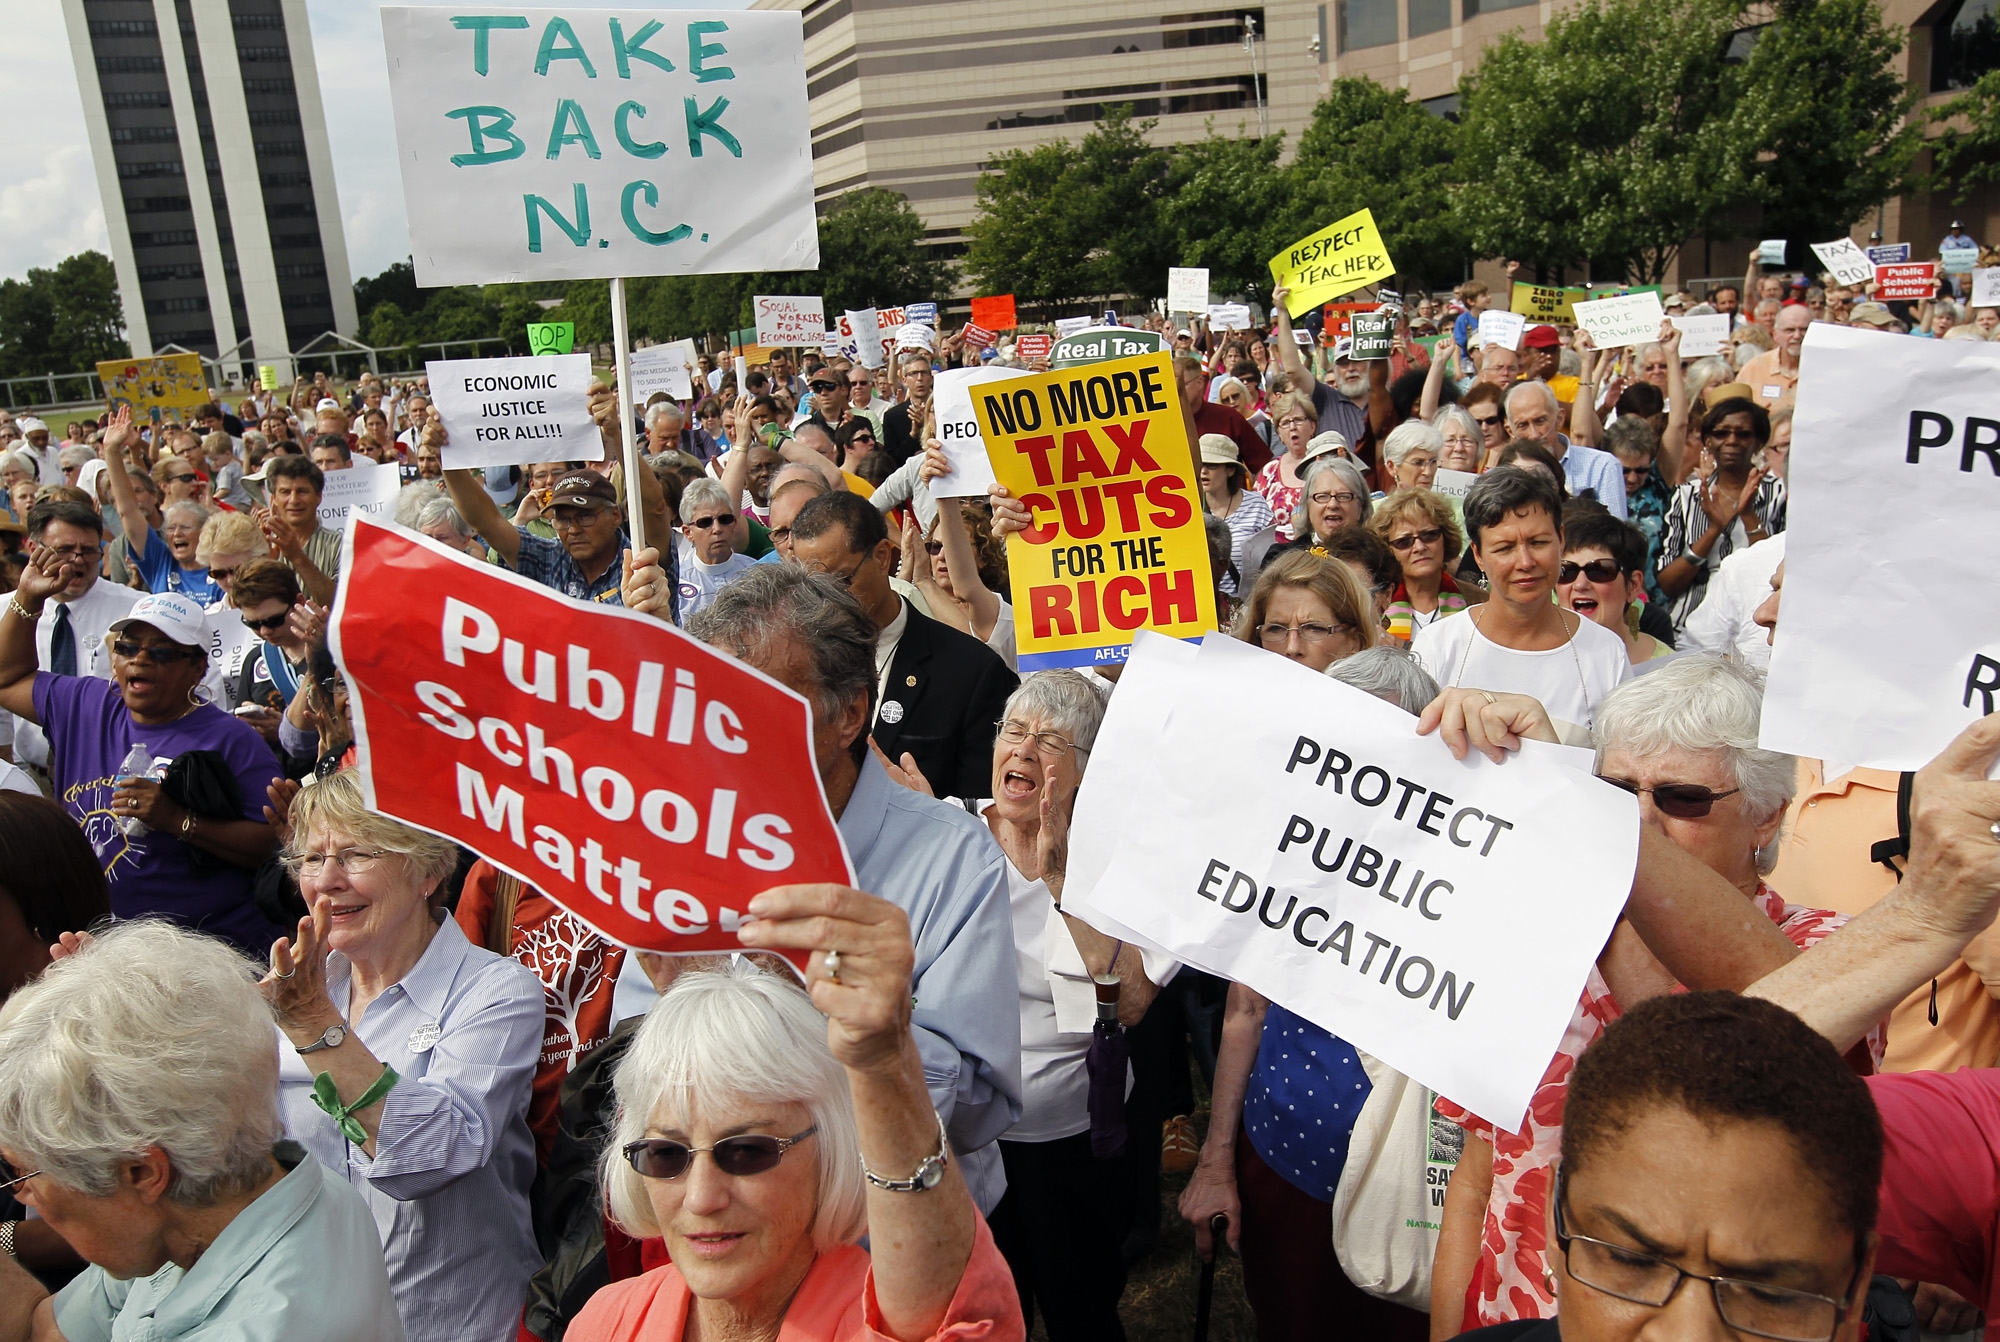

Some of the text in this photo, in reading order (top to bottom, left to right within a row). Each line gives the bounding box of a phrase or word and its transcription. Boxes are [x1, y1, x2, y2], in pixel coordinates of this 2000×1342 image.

[449, 16, 736, 83] TAKE
[445, 94, 742, 168] BACK
[523, 180, 709, 253] N.C.
[1291, 226, 1364, 269] RESPECT
[1817, 242, 1857, 258] TAX
[1296, 254, 1385, 285] TEACHERS
[1887, 267, 1924, 277] Public
[1882, 277, 1927, 287] Schools
[1884, 287, 1925, 296] Matter
[1531, 296, 1563, 305] GUNS
[1532, 287, 1564, 298] ZERO
[1538, 304, 1554, 312] ON
[777, 322, 804, 331] FOR
[778, 313, 823, 324] WORKERS
[840, 308, 906, 337] SENTS
[1356, 319, 1387, 332] Real
[1584, 312, 1633, 327] MOVE
[531, 326, 566, 347] GOP
[971, 327, 990, 339] Public
[1057, 338, 1150, 360] Real Tax
[650, 366, 678, 374] MEDICAID
[464, 373, 558, 393] ECONOMIC
[482, 400, 547, 418] JUSTICE
[984, 366, 1168, 436] NO MORE
[476, 423, 563, 442] FOR ALL!!!
[942, 422, 981, 440] PEO
[1014, 419, 1161, 487] TAX
[554, 476, 591, 491] GUINNESS
[1017, 474, 1192, 545] CUTS
[1051, 536, 1166, 579] FOR THE
[1029, 569, 1198, 639] RICH
[442, 596, 748, 755] Public
[414, 680, 795, 872] Schools
[1284, 735, 1514, 858] PROTECT
[1277, 814, 1454, 921] PUBLIC
[1196, 858, 1475, 1021] EDUCATION
